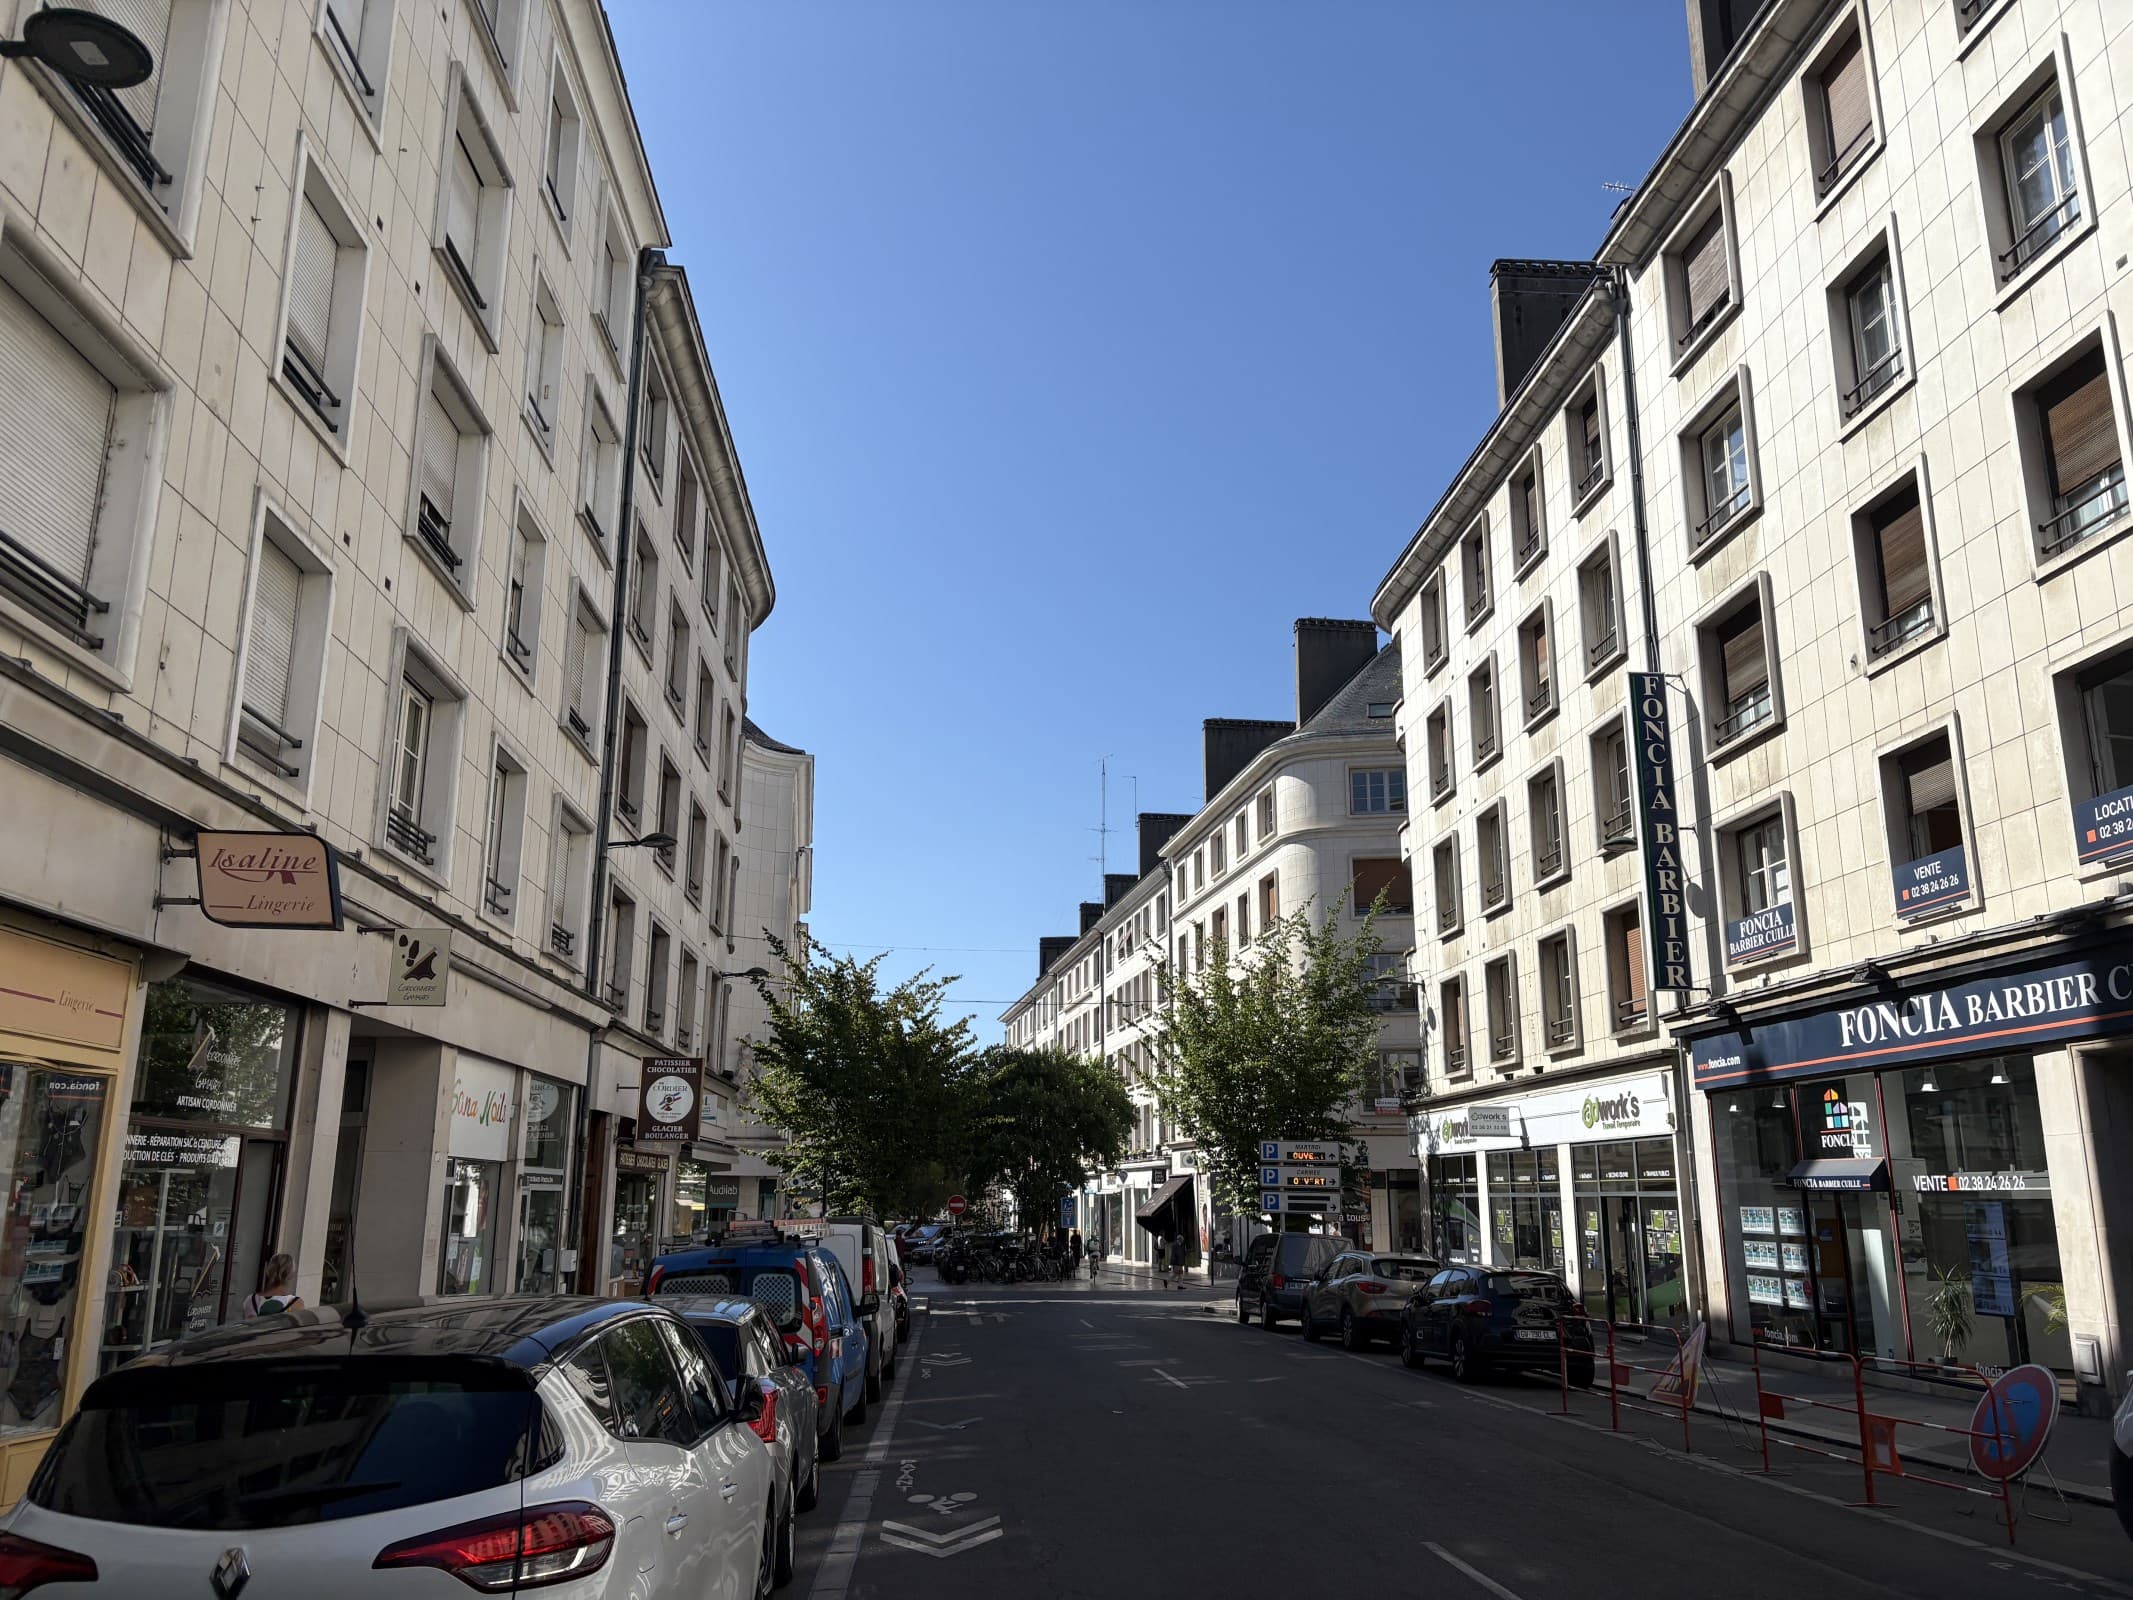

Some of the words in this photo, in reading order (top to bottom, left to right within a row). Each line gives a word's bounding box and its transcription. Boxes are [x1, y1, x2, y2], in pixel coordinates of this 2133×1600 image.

[1642, 675, 1673, 810] FONCIA
[2099, 825, 2111, 839] 02
[2112, 821, 2124, 836] 38
[208, 847, 317, 870] Isaline
[1914, 861, 1942, 881] VENTE
[1911, 886, 1920, 898] 02
[1920, 884, 1930, 896] 38
[1930, 881, 1940, 893] 24
[1939, 877, 1949, 890] 26
[1949, 874, 1959, 887] 26
[246, 895, 315, 915] Lingerie
[1655, 822, 1687, 987] BARBIER
[1739, 910, 1783, 938] FONCIA
[1730, 934, 1765, 954] BARBIER
[58, 989, 95, 1013] Lingerie
[1837, 989, 1962, 1047] FONCIA
[1966, 972, 2103, 1026] BARBIER
[2107, 964, 2133, 1001] C
[647, 1066, 697, 1074] CHOCOLATIER
[654, 1059, 691, 1067] PATISSIER
[176, 1095, 202, 1109] ARTISAN
[202, 1097, 238, 1113] CORDONNIER
[645, 1132, 689, 1140] BOULANGER
[1820, 1132, 1857, 1148] FONCIA
[151, 1151, 160, 1162] DE
[709, 1184, 738, 1196] Audilab
[1793, 1178, 1818, 1188] FONCIA
[1818, 1179, 1841, 1188] BARBIER
[1913, 1175, 1948, 1192] VENTE
